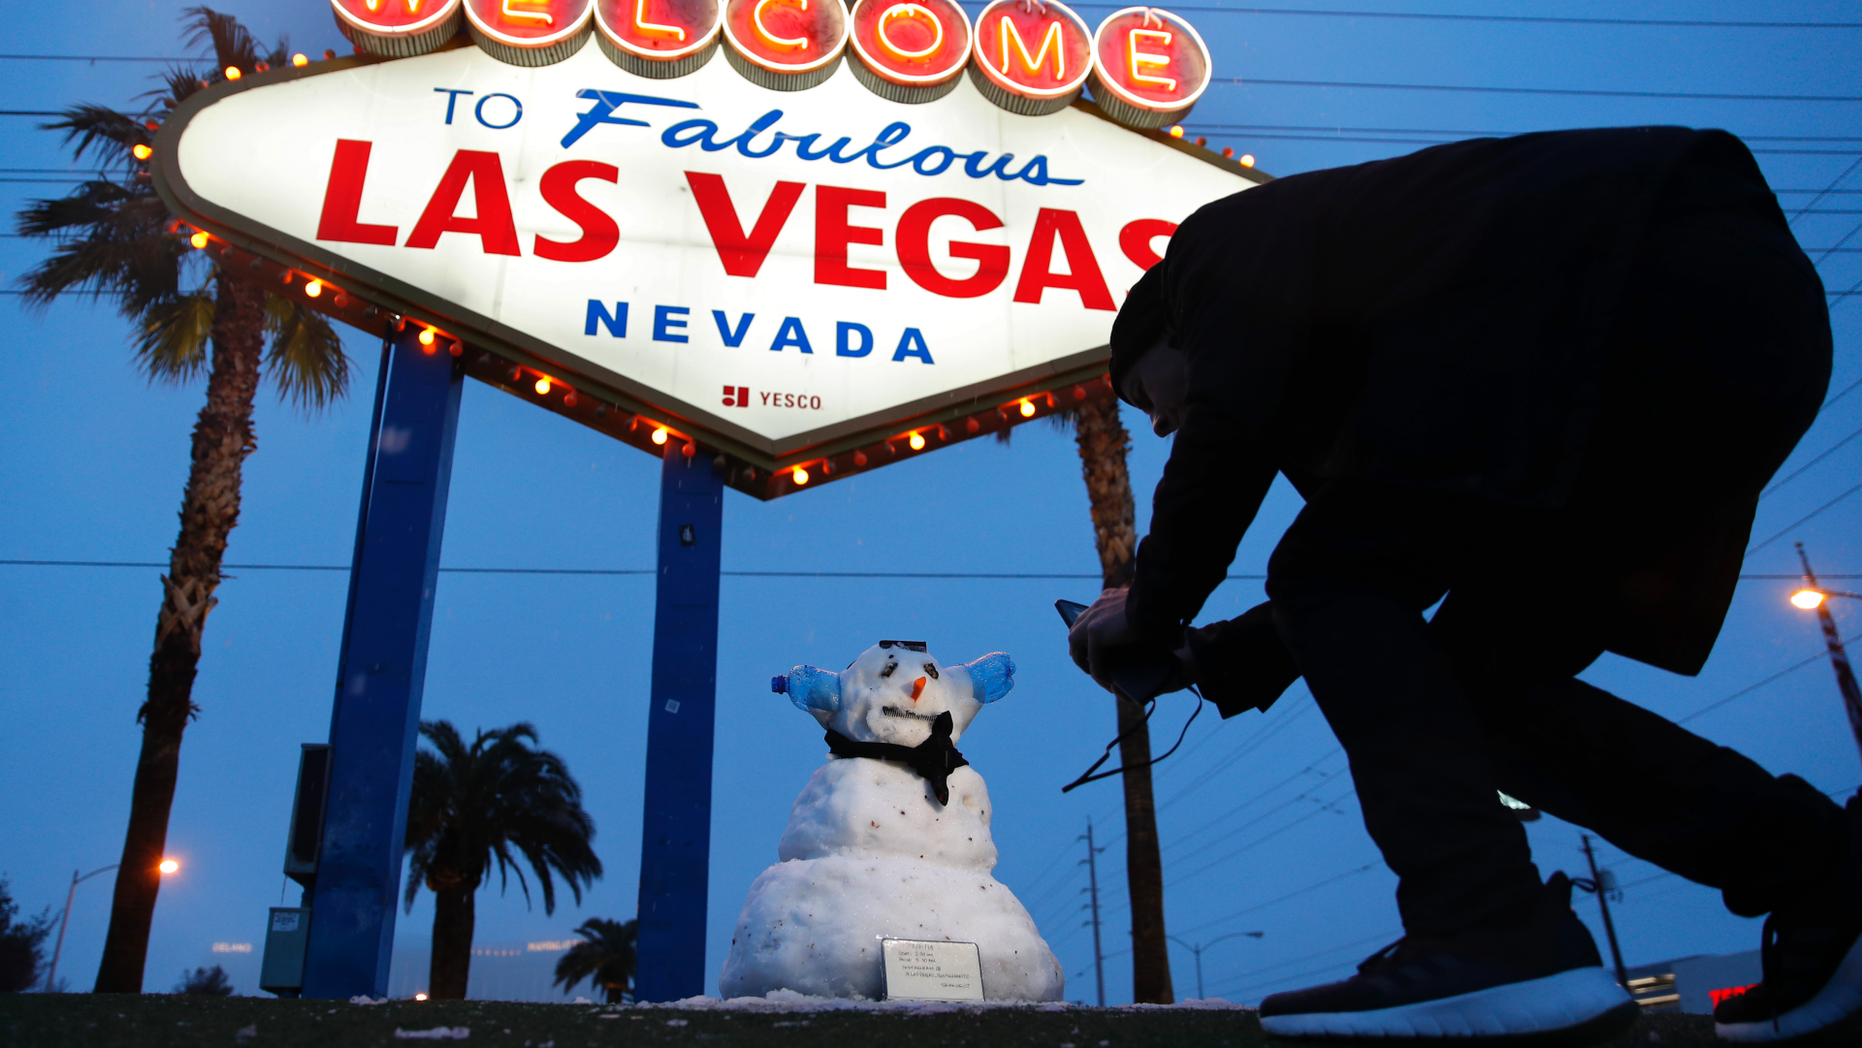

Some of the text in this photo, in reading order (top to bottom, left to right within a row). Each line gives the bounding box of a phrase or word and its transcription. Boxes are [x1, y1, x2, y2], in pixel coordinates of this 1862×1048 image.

[364, 0, 1177, 91] LCOME
[433, 87, 1086, 187] TO Fabulous
[315, 138, 621, 263] LAS
[584, 298, 936, 365] NEVADA
[760, 391, 822, 411] YESCO
